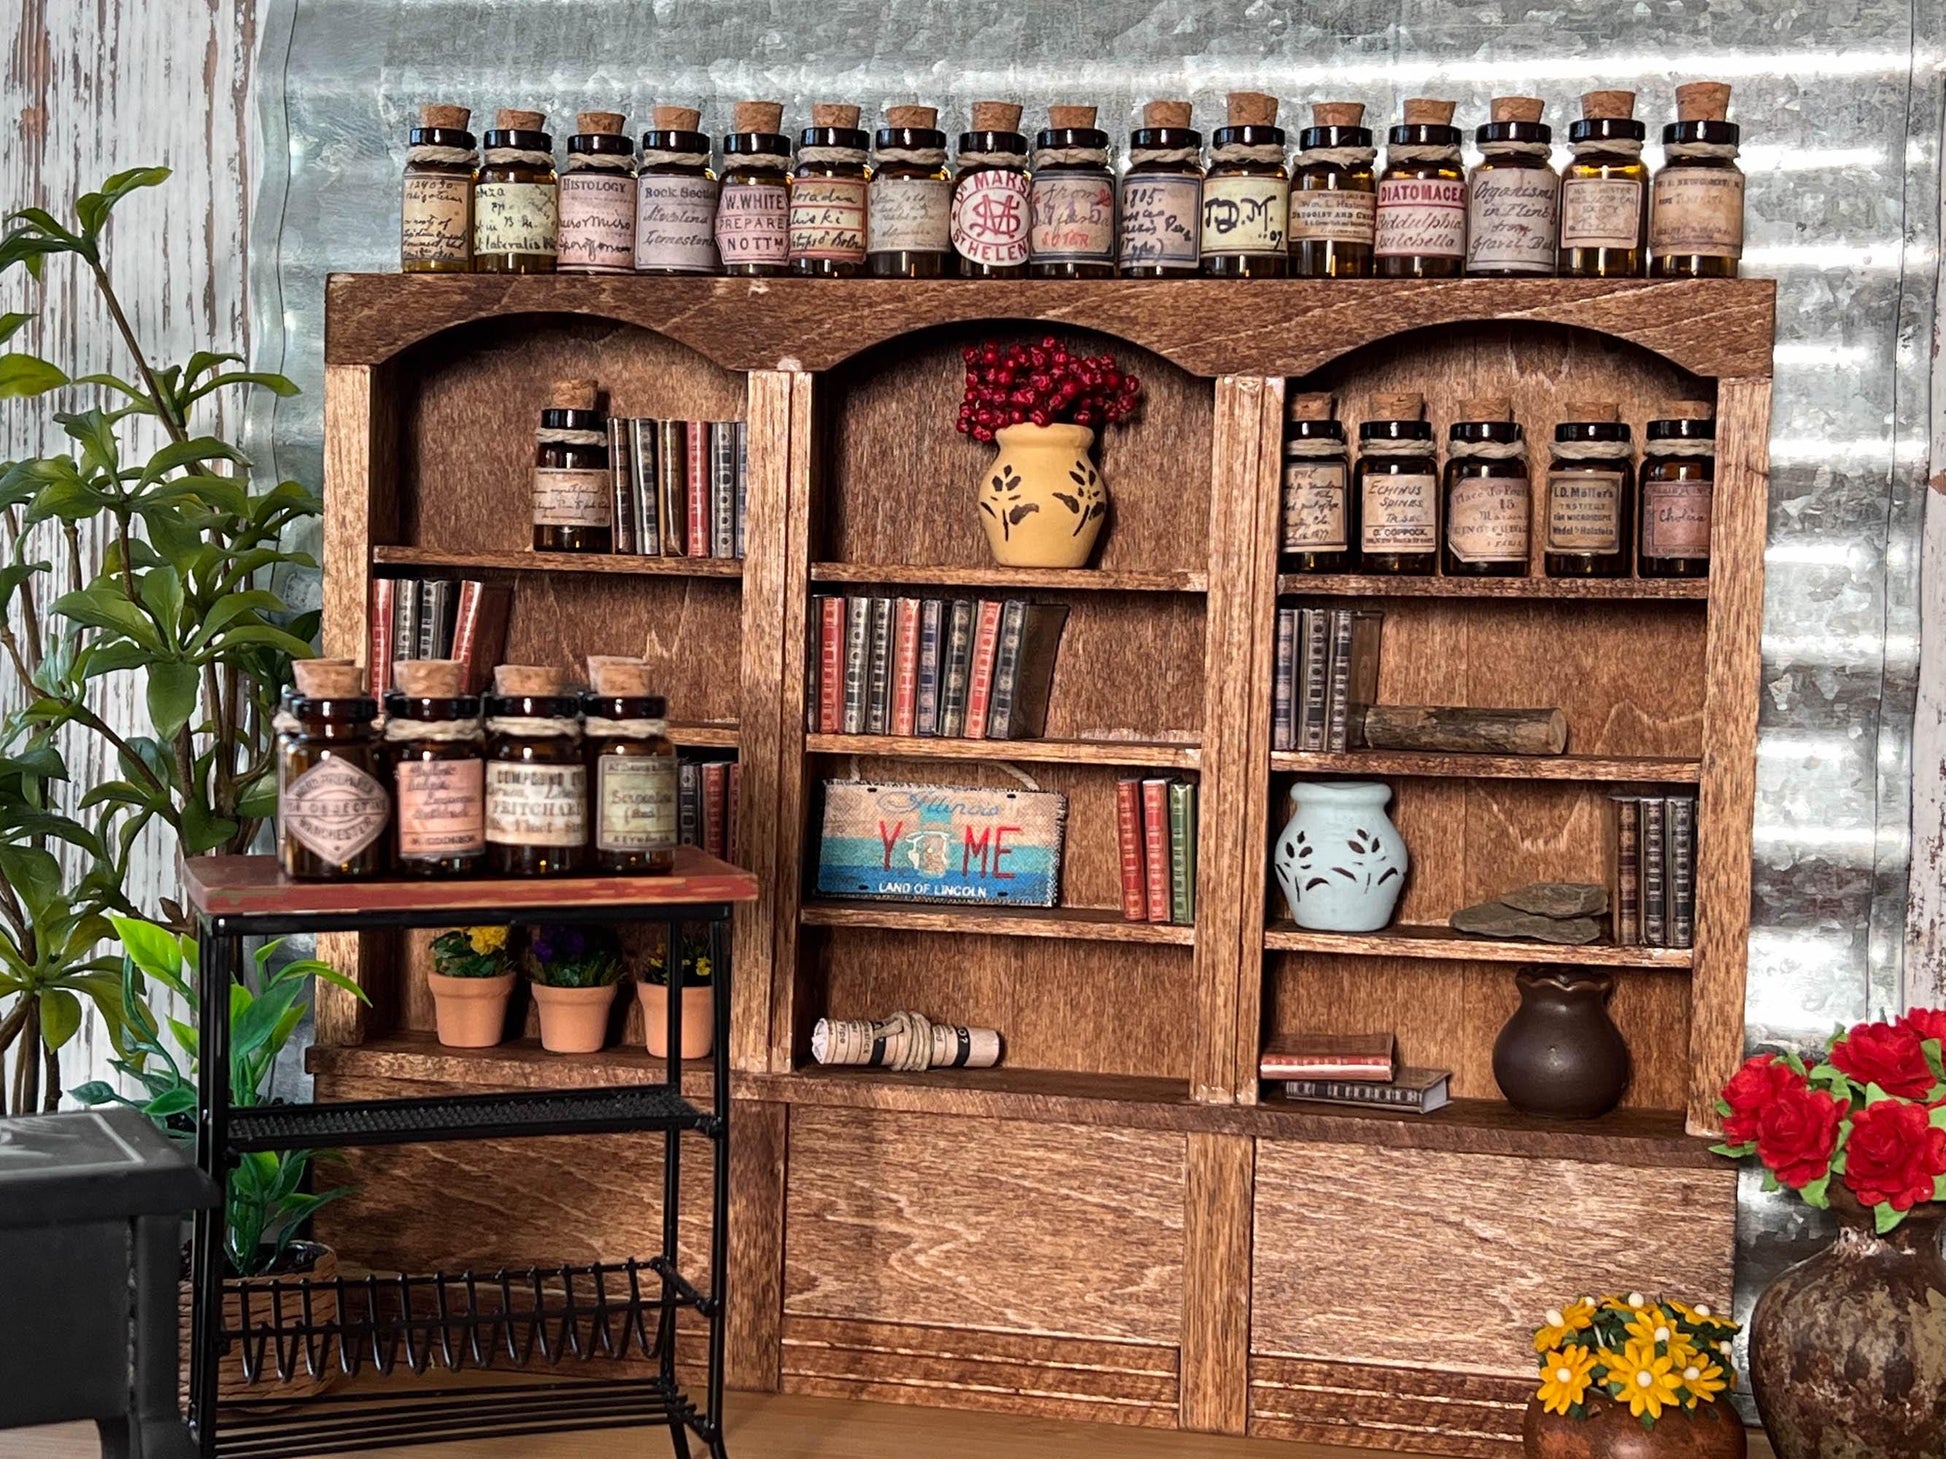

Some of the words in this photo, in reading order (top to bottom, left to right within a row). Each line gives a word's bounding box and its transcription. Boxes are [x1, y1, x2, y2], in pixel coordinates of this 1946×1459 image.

[879, 820, 903, 873] Y
[961, 825, 1023, 879] ME
[878, 882, 911, 894] LAND
[913, 883, 932, 894] OF
[934, 885, 988, 899] LINCOLN
